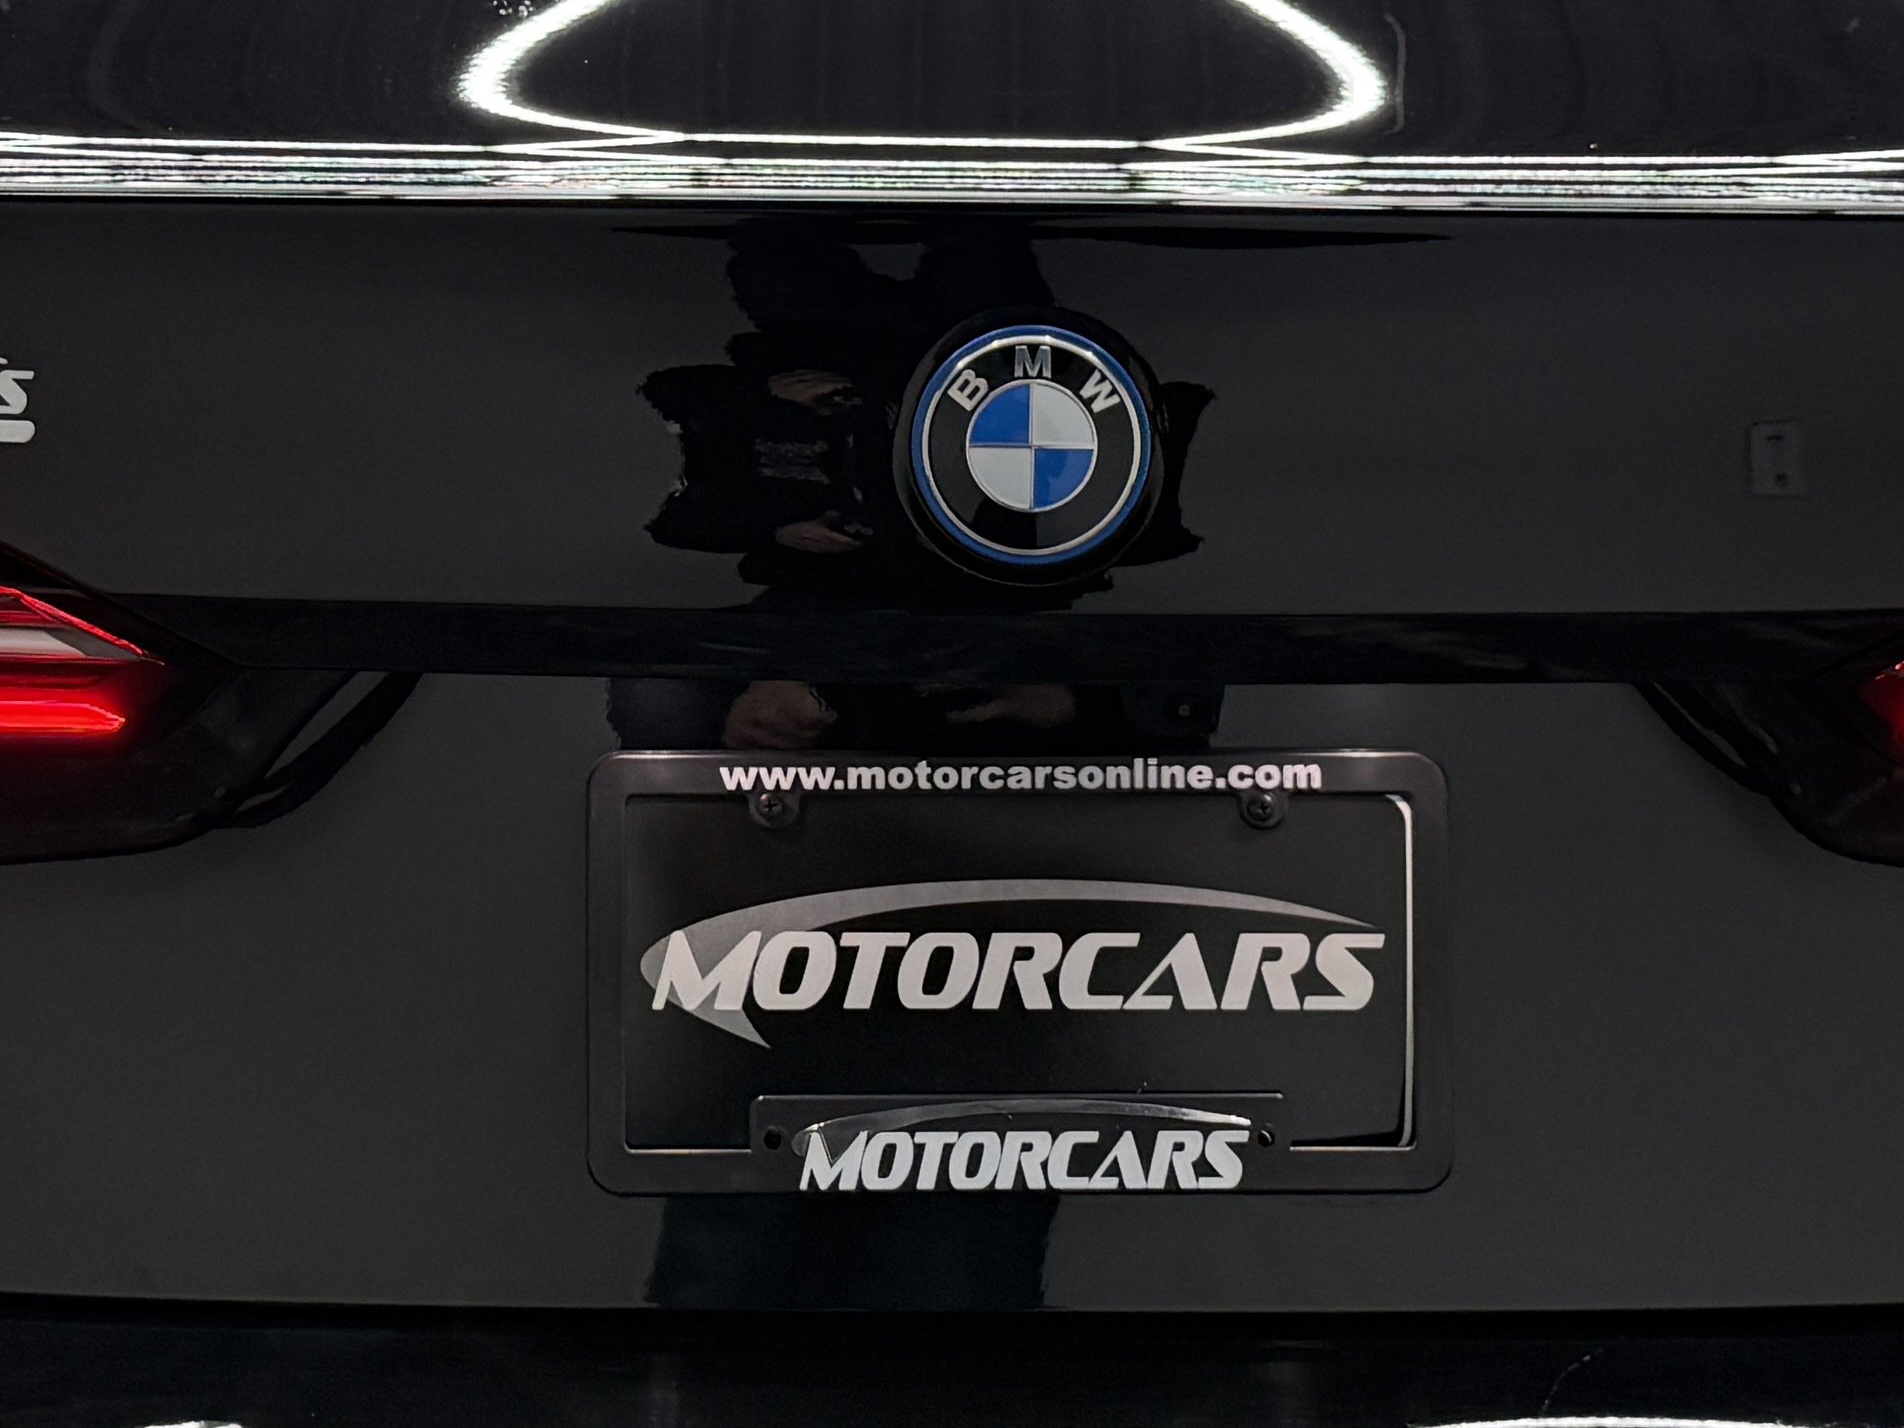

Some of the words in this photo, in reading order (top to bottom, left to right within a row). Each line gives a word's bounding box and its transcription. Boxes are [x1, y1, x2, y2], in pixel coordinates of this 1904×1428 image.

[947, 345, 1121, 413] BMW
[719, 758, 1322, 791] www.motorcarsonline.com
[652, 928, 1386, 1012] MOTORCARS
[798, 1126, 1249, 1191] MOTORCARS
